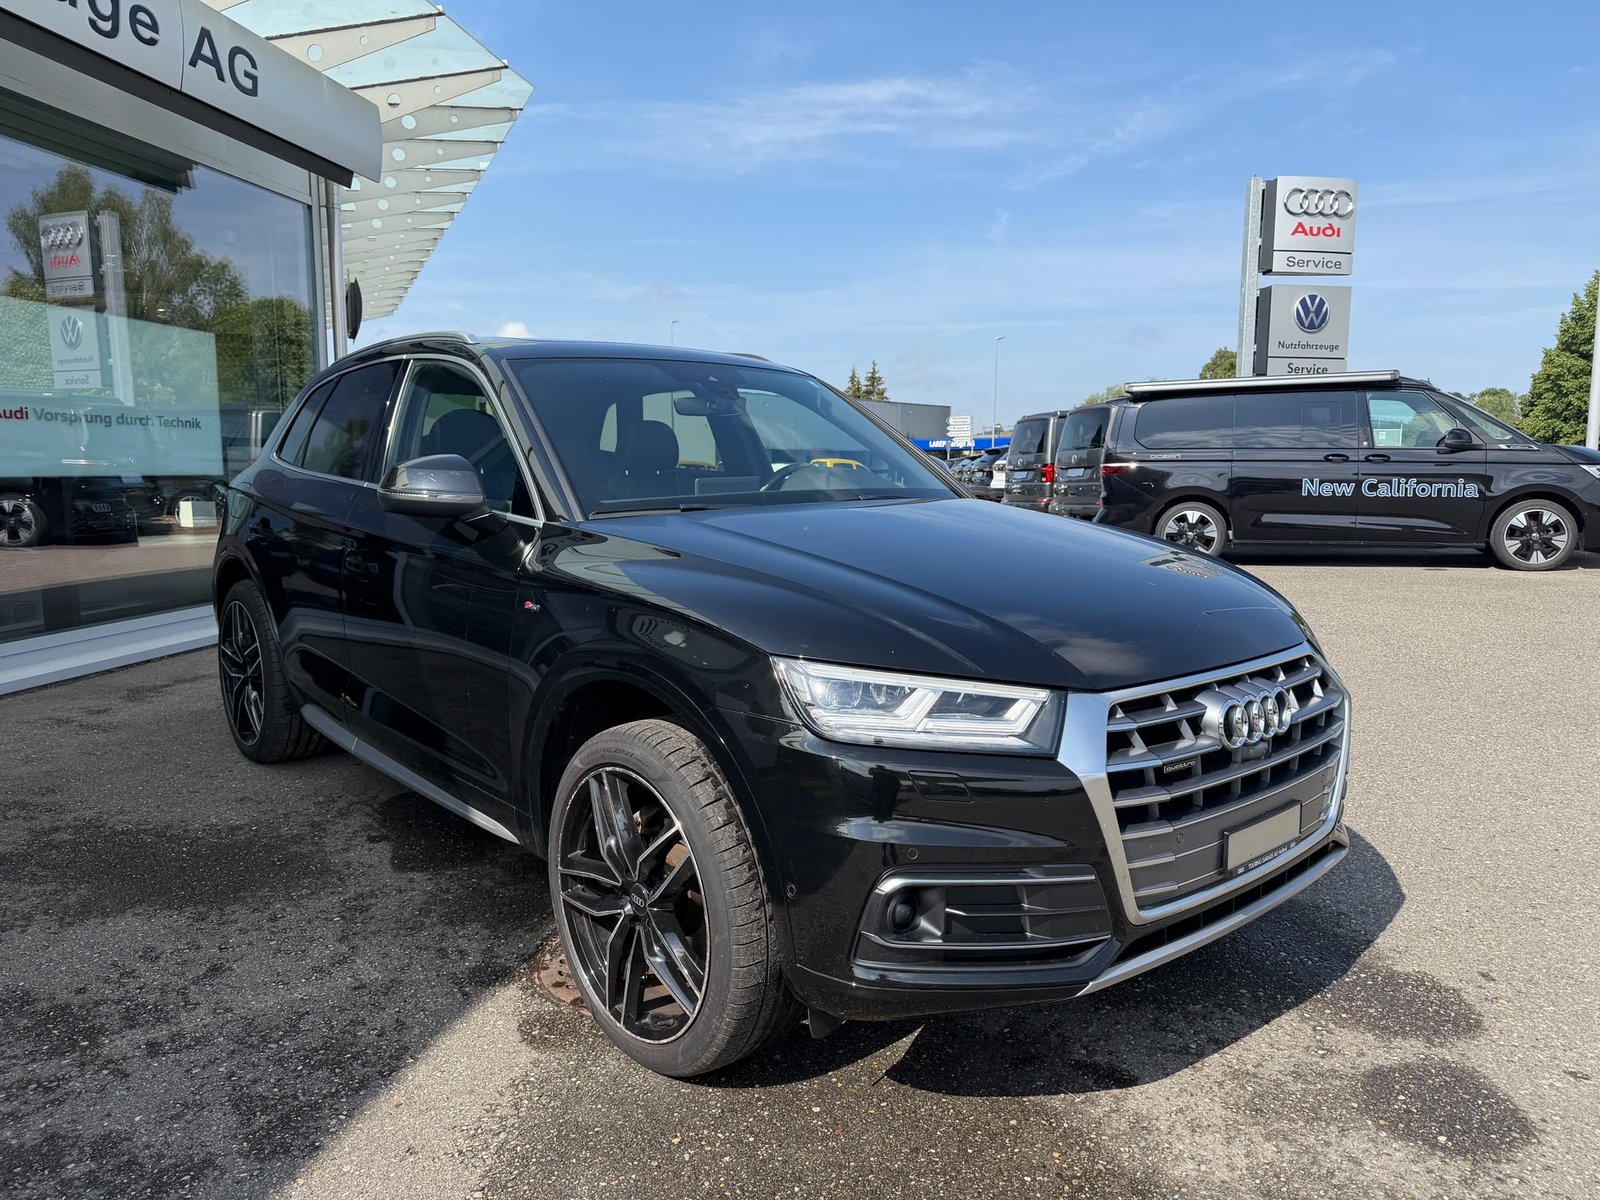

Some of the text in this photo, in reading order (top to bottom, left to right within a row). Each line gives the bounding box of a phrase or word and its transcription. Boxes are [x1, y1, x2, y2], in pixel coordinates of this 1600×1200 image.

[57, 0, 258, 97] ge AG
[1291, 222, 1341, 238] Audi
[1286, 256, 1342, 269] Service
[1278, 341, 1339, 352] Nutzfahrzeuge
[1287, 362, 1328, 375] Service
[0, 407, 202, 429] udi Vorsprung durch Technik
[1301, 478, 1479, 498] New California
